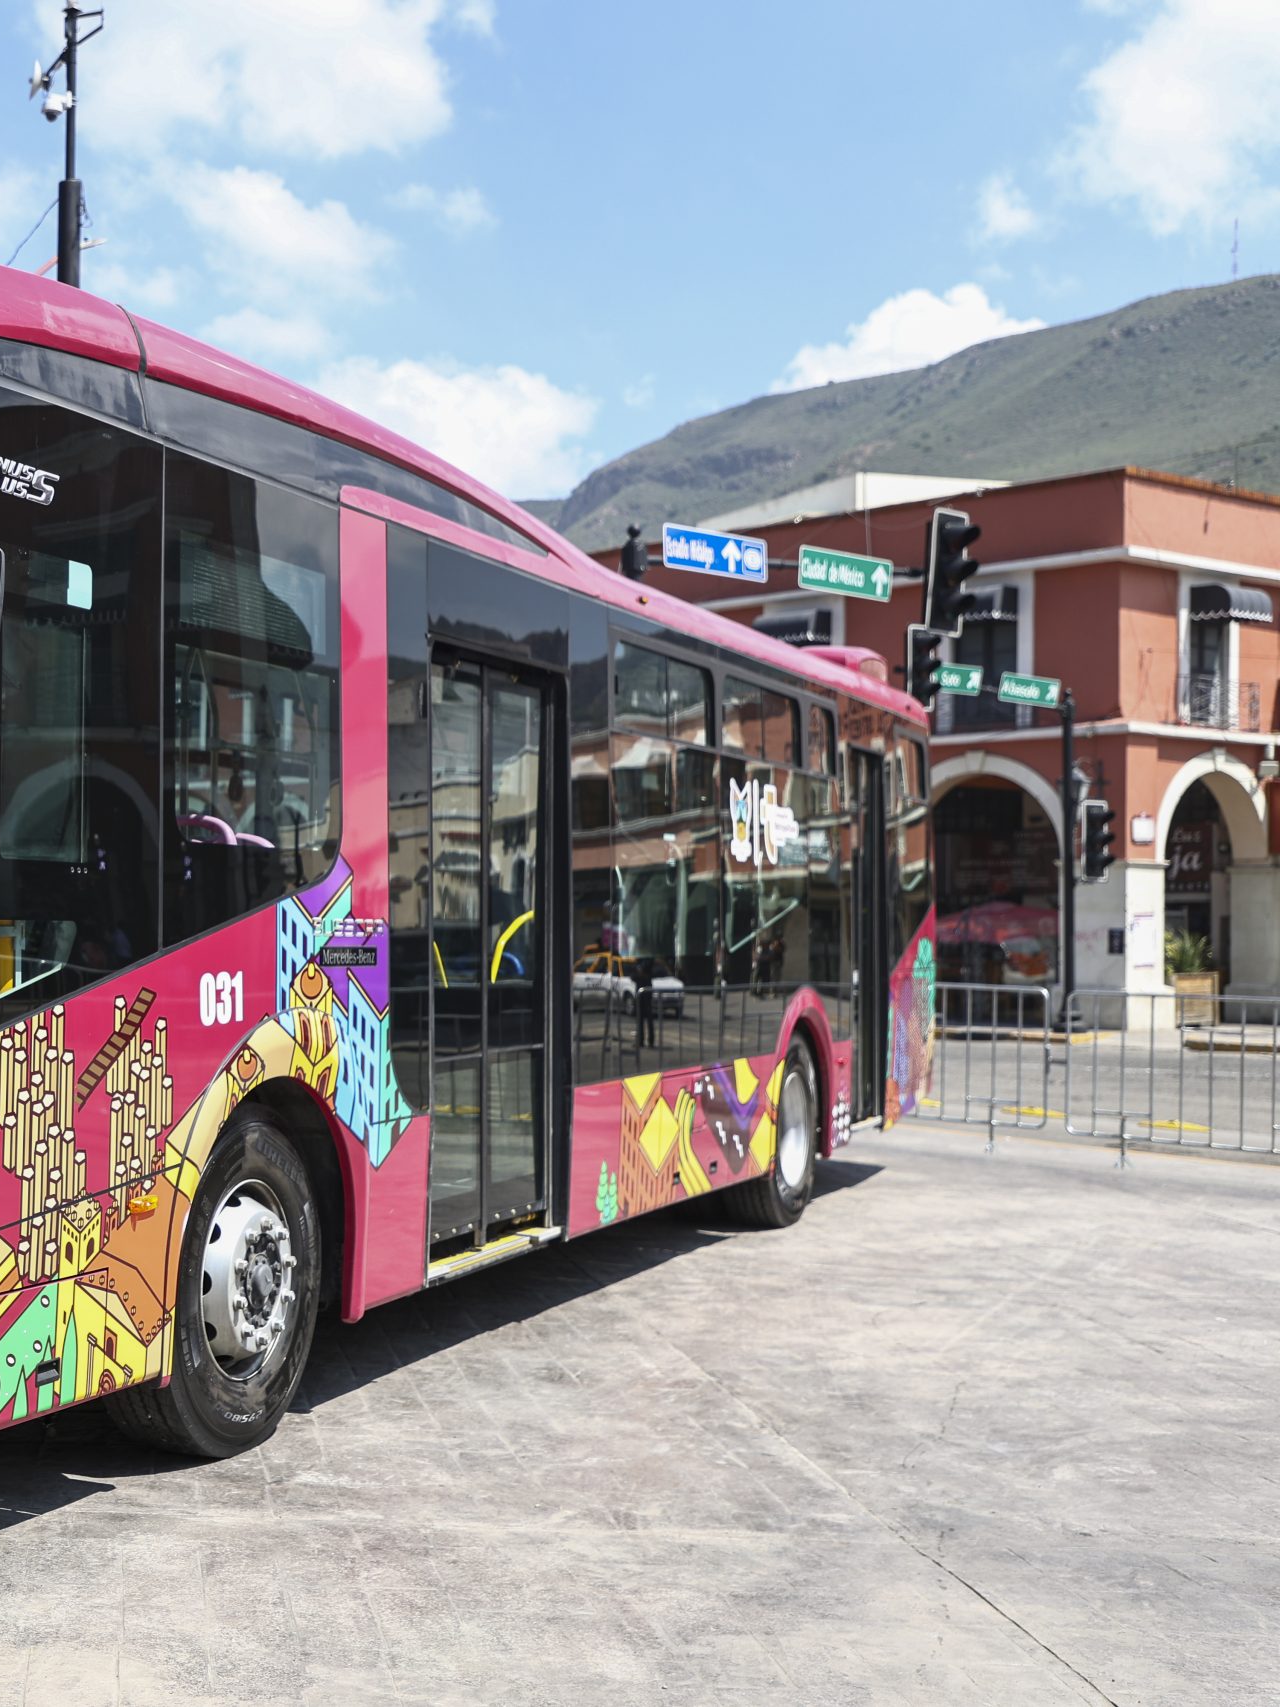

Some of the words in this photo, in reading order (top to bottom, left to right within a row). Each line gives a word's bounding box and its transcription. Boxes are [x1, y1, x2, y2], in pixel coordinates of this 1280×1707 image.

[31, 469, 60, 506] S
[802, 557, 827, 581] Ciudad
[828, 562, 838, 582] de
[838, 563, 865, 587] México
[322, 950, 376, 966] Mercedes-Benz
[199, 970, 244, 1027] 031
